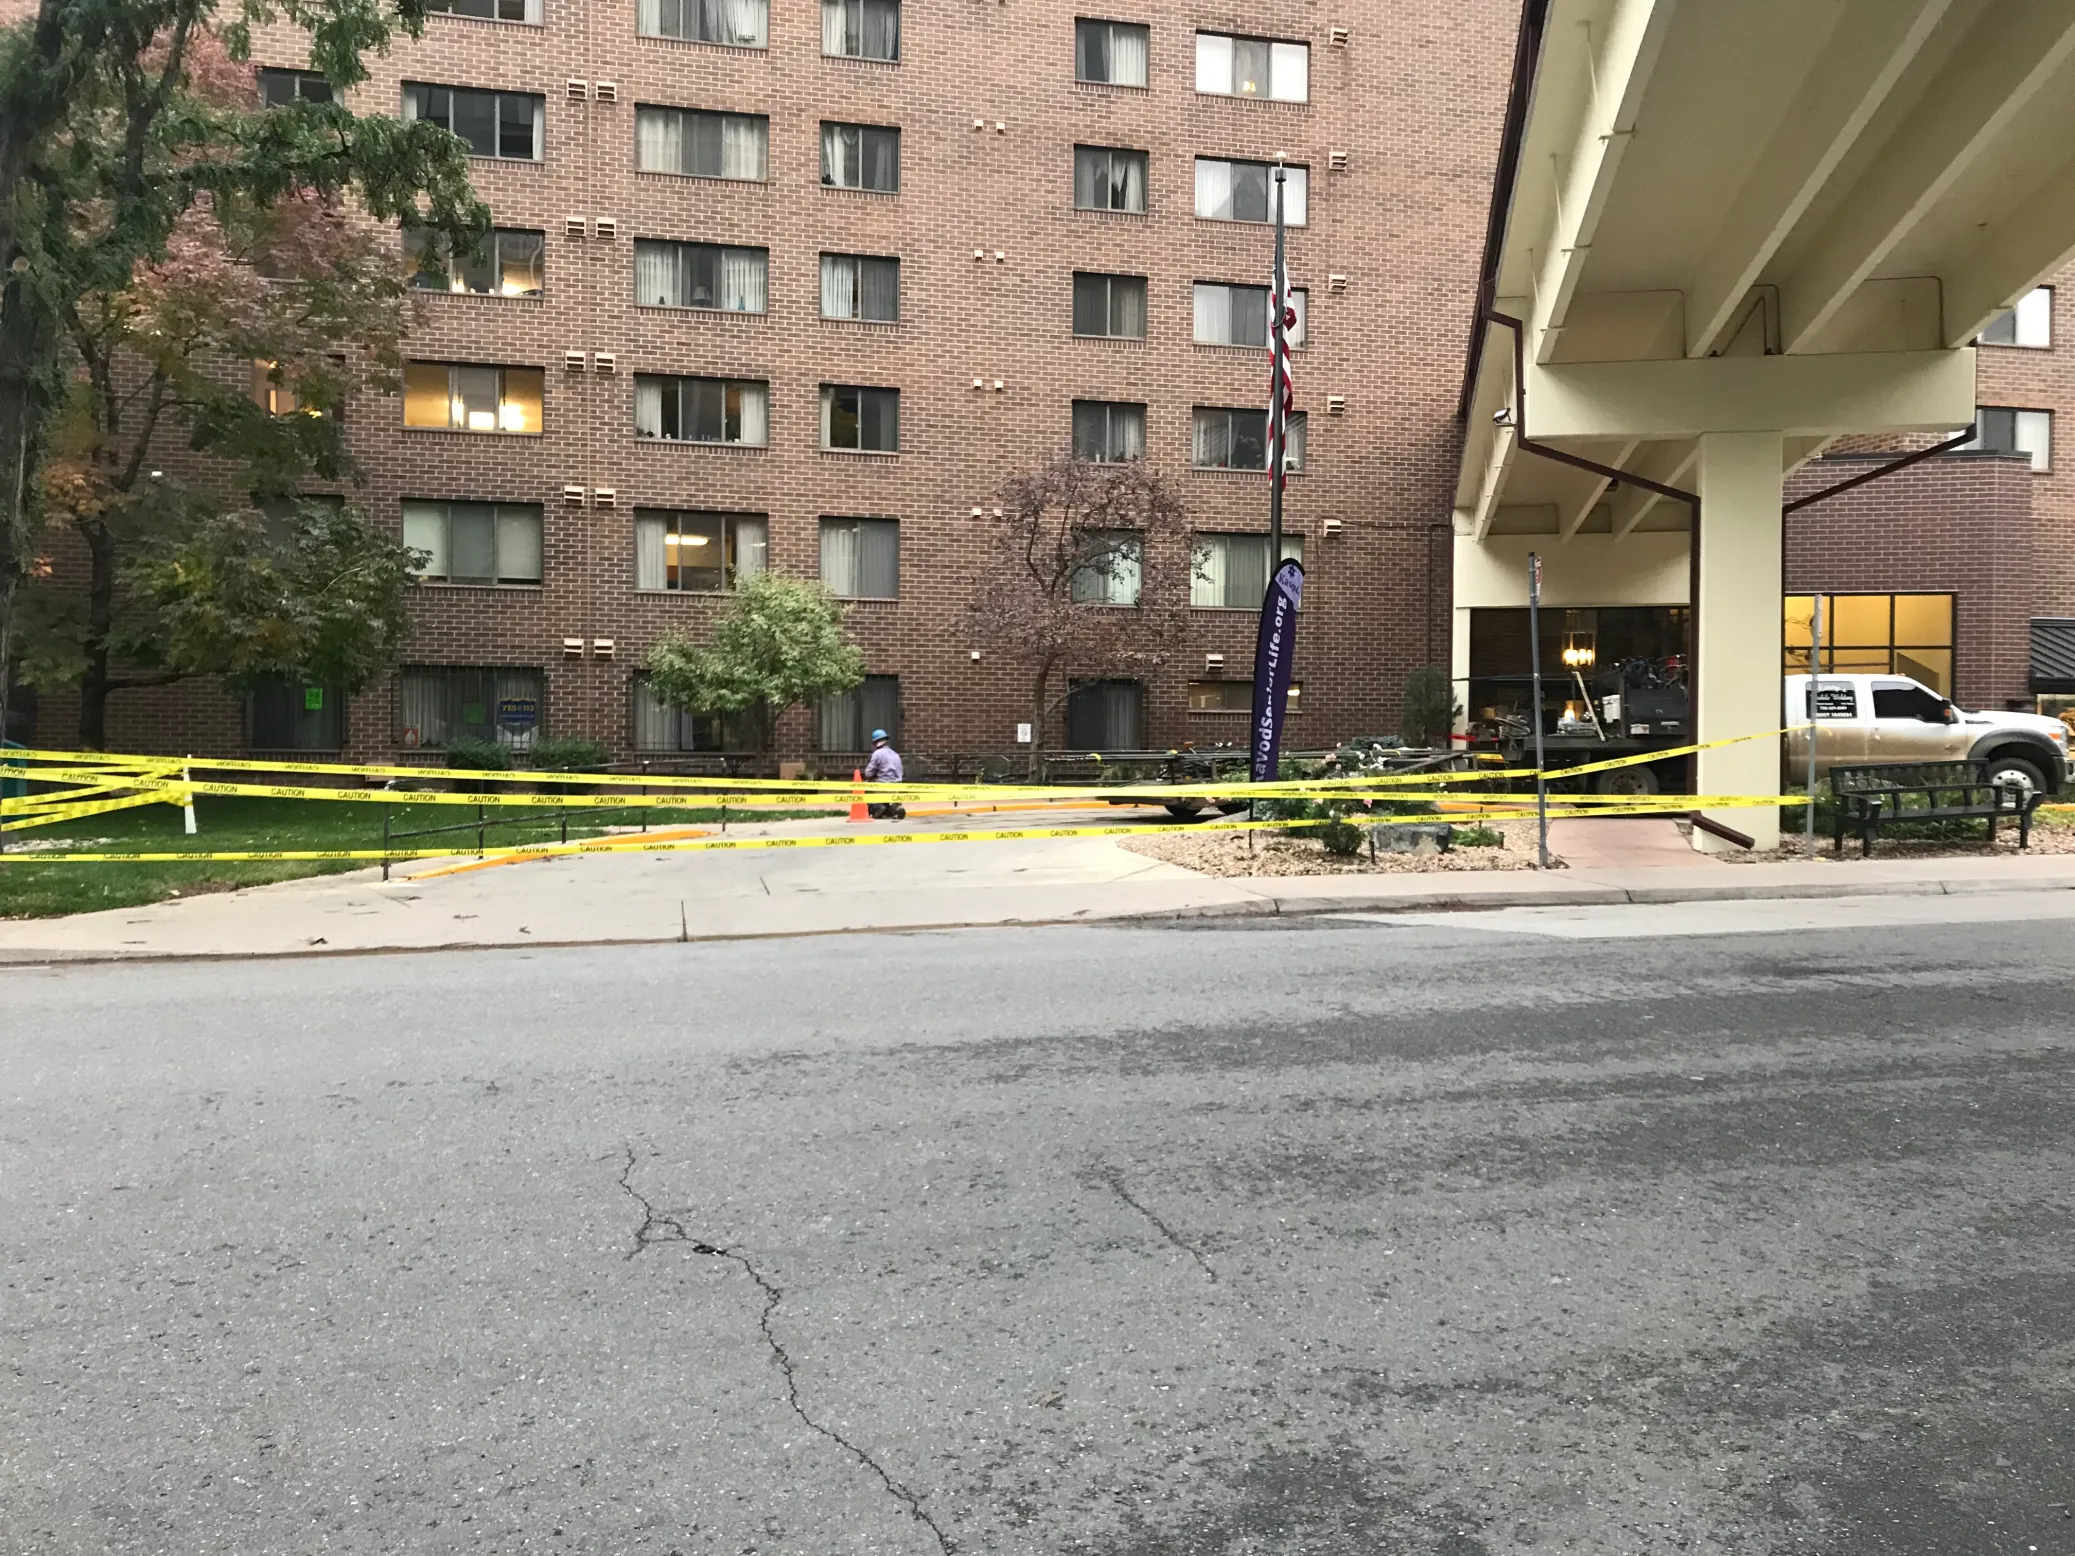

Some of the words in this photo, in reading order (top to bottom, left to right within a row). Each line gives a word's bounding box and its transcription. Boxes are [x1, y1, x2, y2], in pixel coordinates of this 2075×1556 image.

[0, 768, 26, 777] UTION
[62, 772, 98, 783] CAUTION
[134, 779, 168, 789] CAUTION
[203, 784, 238, 793] CAUTION
[271, 787, 305, 797] CAUTION
[338, 791, 371, 800] CAUTION
[403, 794, 436, 802] CAUTION
[468, 796, 500, 804] CAUTION
[656, 796, 687, 804] CAUTION
[716, 796, 747, 804] CAUTION
[776, 796, 806, 804] CAUTION
[892, 794, 920, 802] CAUTION
[1427, 774, 1454, 782] CAUTION
[1478, 771, 1505, 779] CAUTION
[450, 848, 484, 856] CAUTION
[766, 839, 796, 848] CAUTION
[826, 837, 855, 845] CAUTION
[883, 836, 912, 844] CAUTION
[940, 833, 968, 841] CAUTION
[1104, 828, 1132, 836] CAUTION
